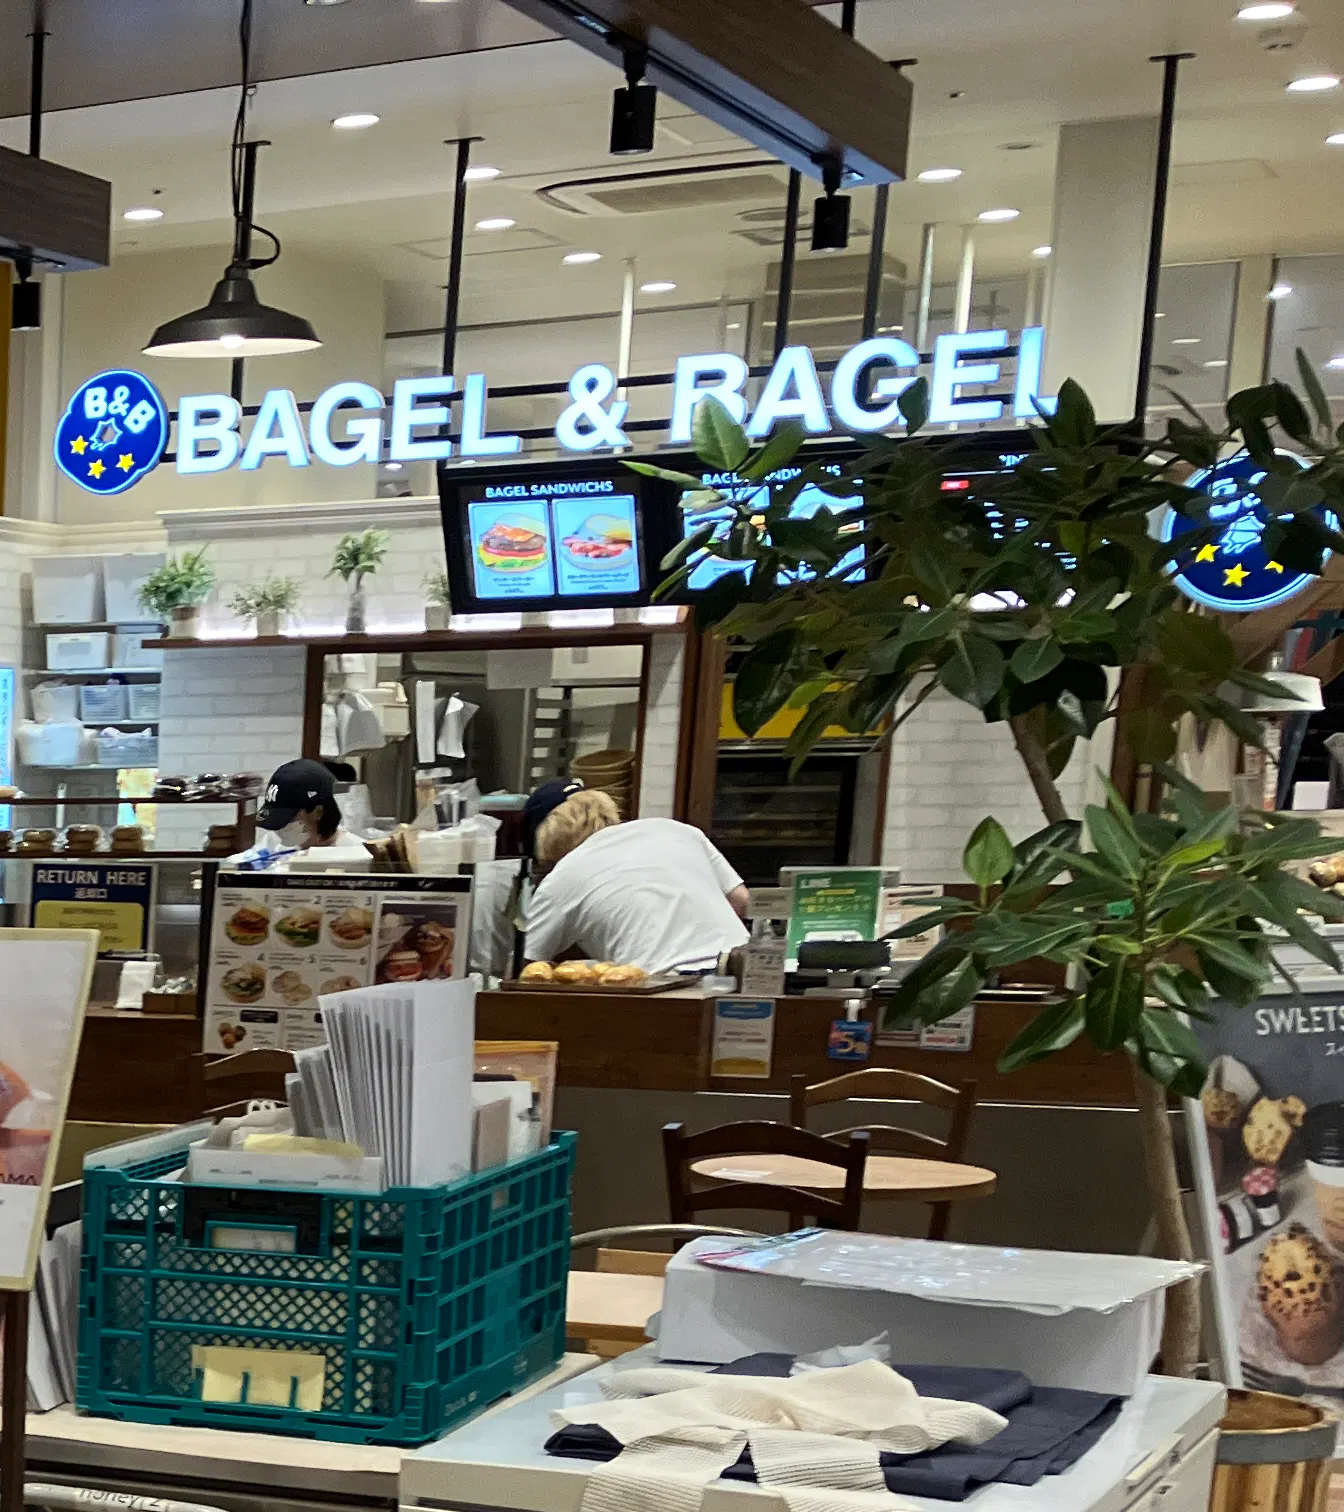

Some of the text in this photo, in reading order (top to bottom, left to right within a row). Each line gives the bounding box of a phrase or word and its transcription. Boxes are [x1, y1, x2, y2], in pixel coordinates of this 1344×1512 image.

[176, 372, 522, 475] BAGEL
[554, 362, 630, 453] &
[485, 480, 614, 499] BAGEL SANDWICHS
[37, 869, 147, 886] RETURN HERE
